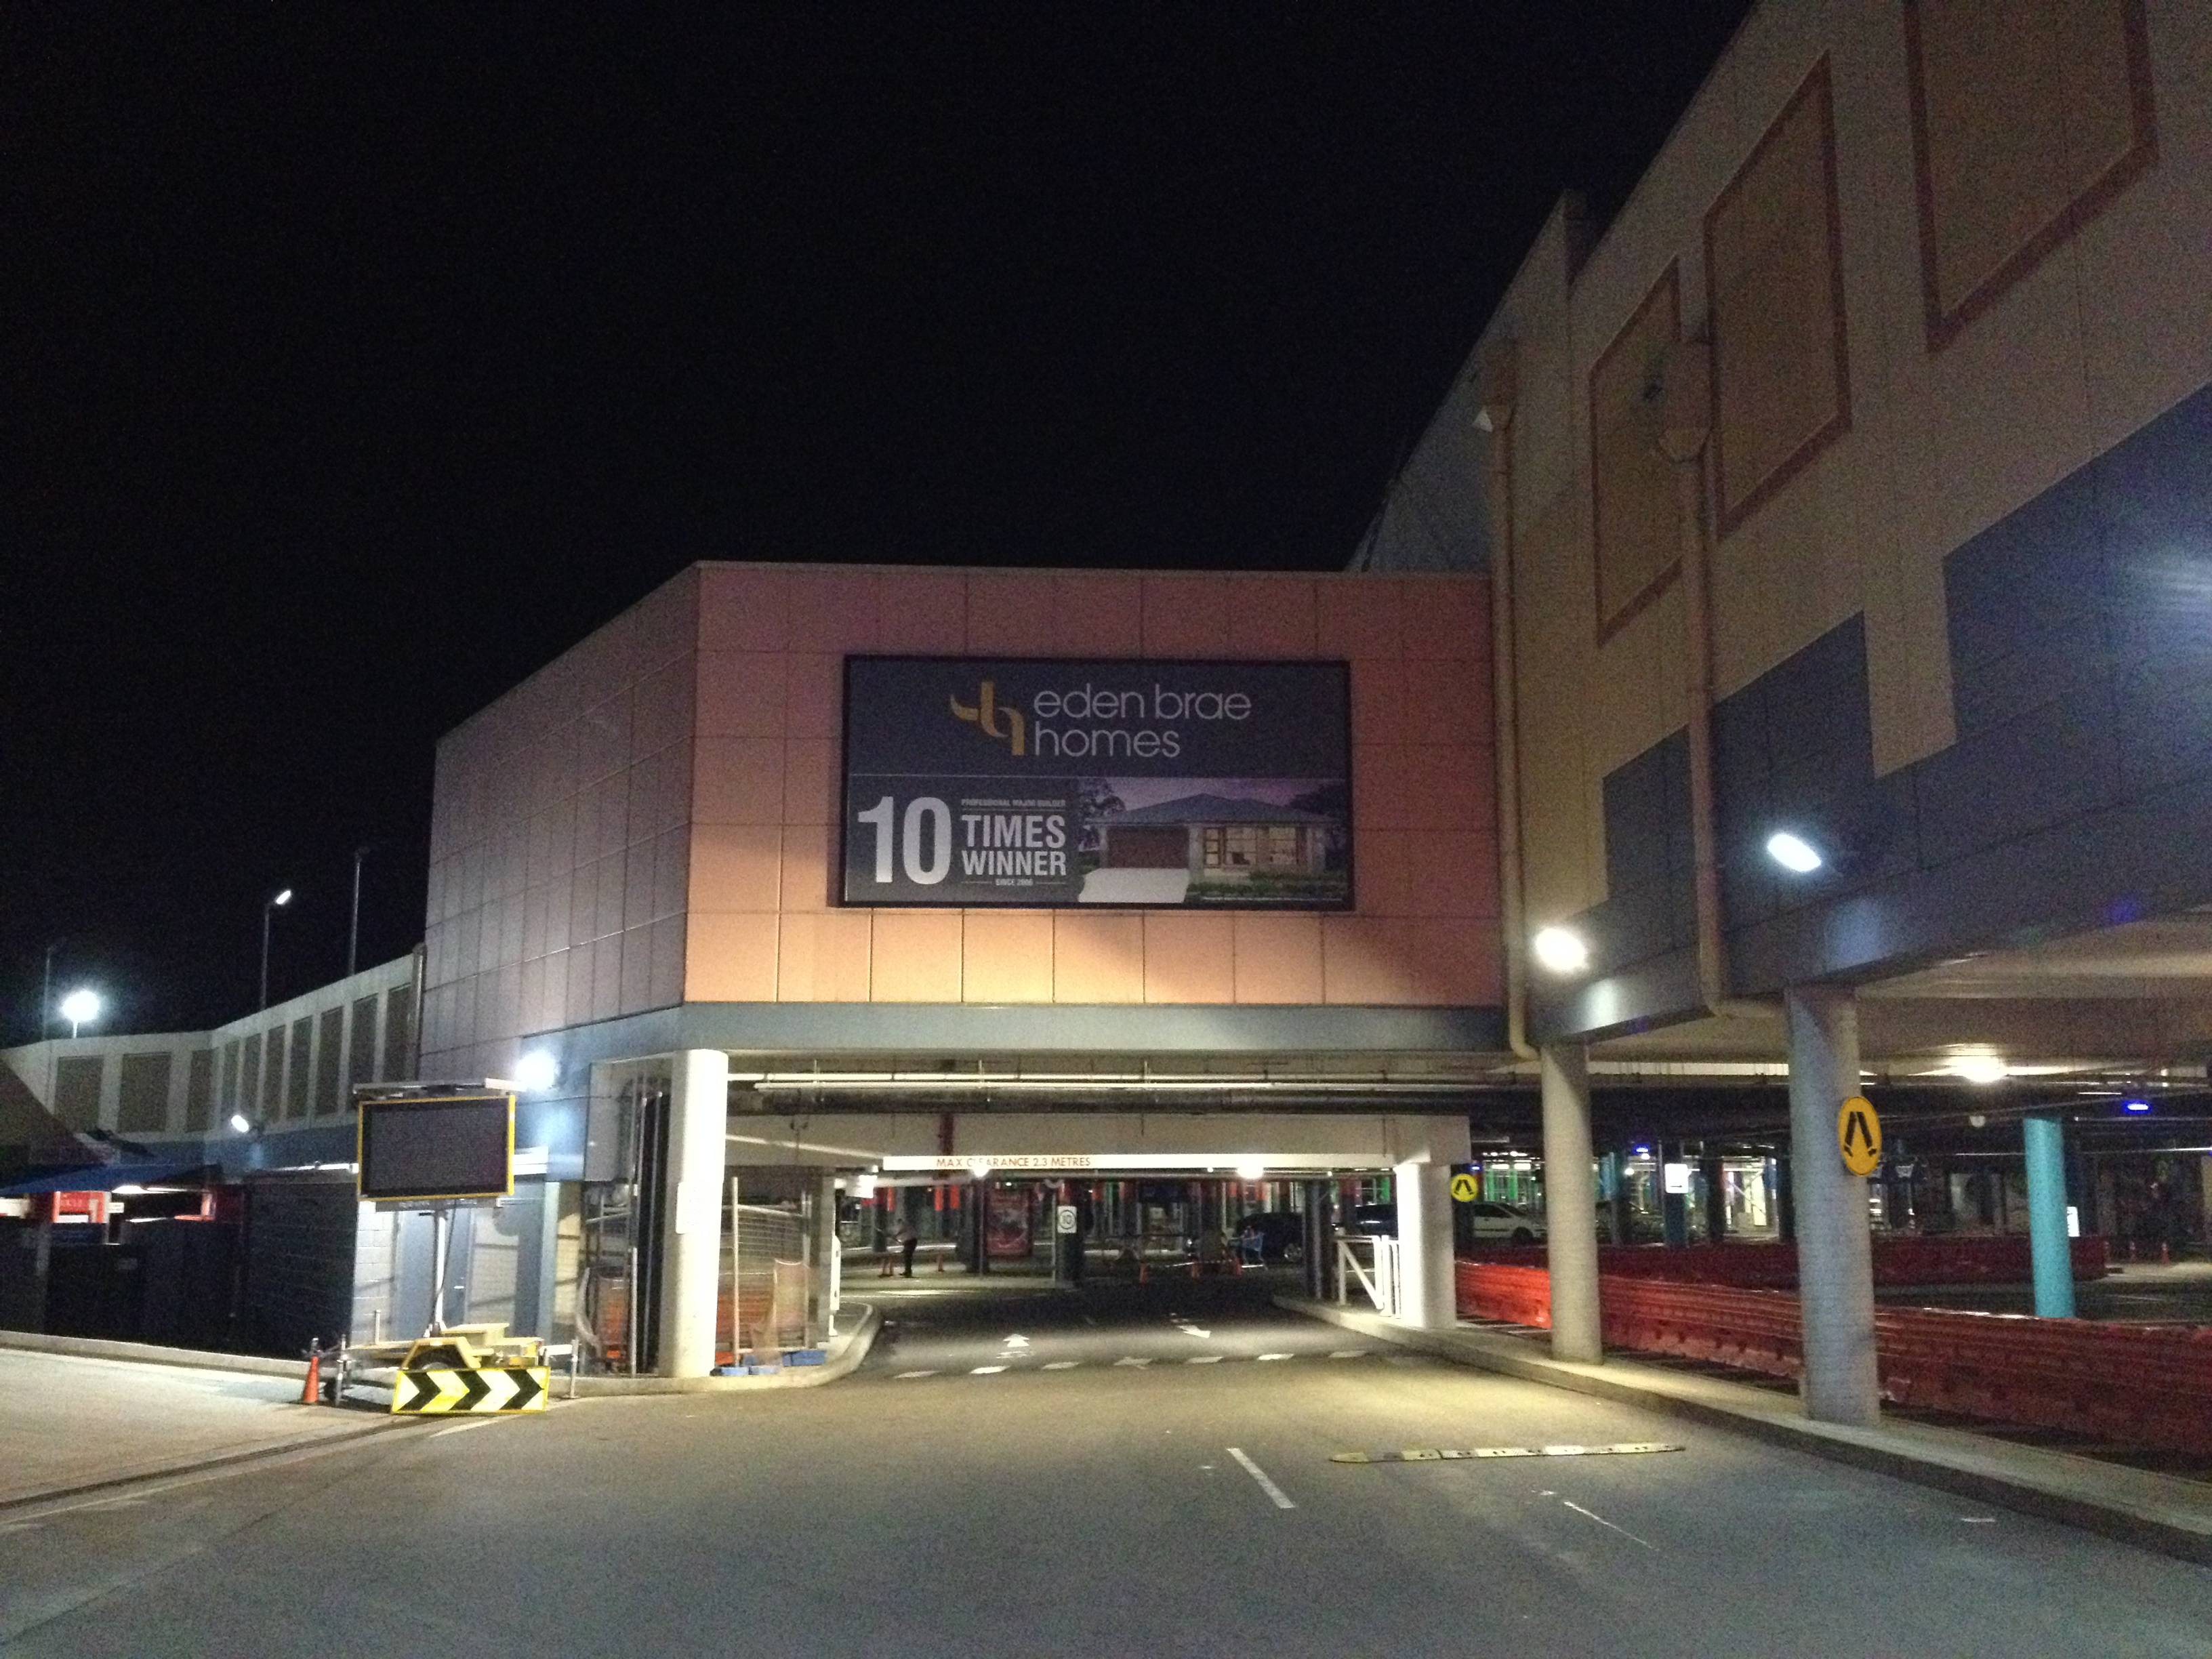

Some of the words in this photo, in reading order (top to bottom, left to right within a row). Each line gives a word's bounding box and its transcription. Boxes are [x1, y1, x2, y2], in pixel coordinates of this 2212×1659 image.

[1033, 682, 1145, 718] eden
[1155, 683, 1252, 720] brae
[1035, 720, 1181, 757] homes
[857, 796, 952, 884] 10
[961, 815, 1066, 848] TIMES
[961, 850, 1067, 876] WINNER
[936, 1158, 962, 1167] MAX
[966, 1158, 1029, 1167] CARANCE
[1033, 1158, 1048, 1166] 2.3
[1051, 1157, 1091, 1166] METRES
